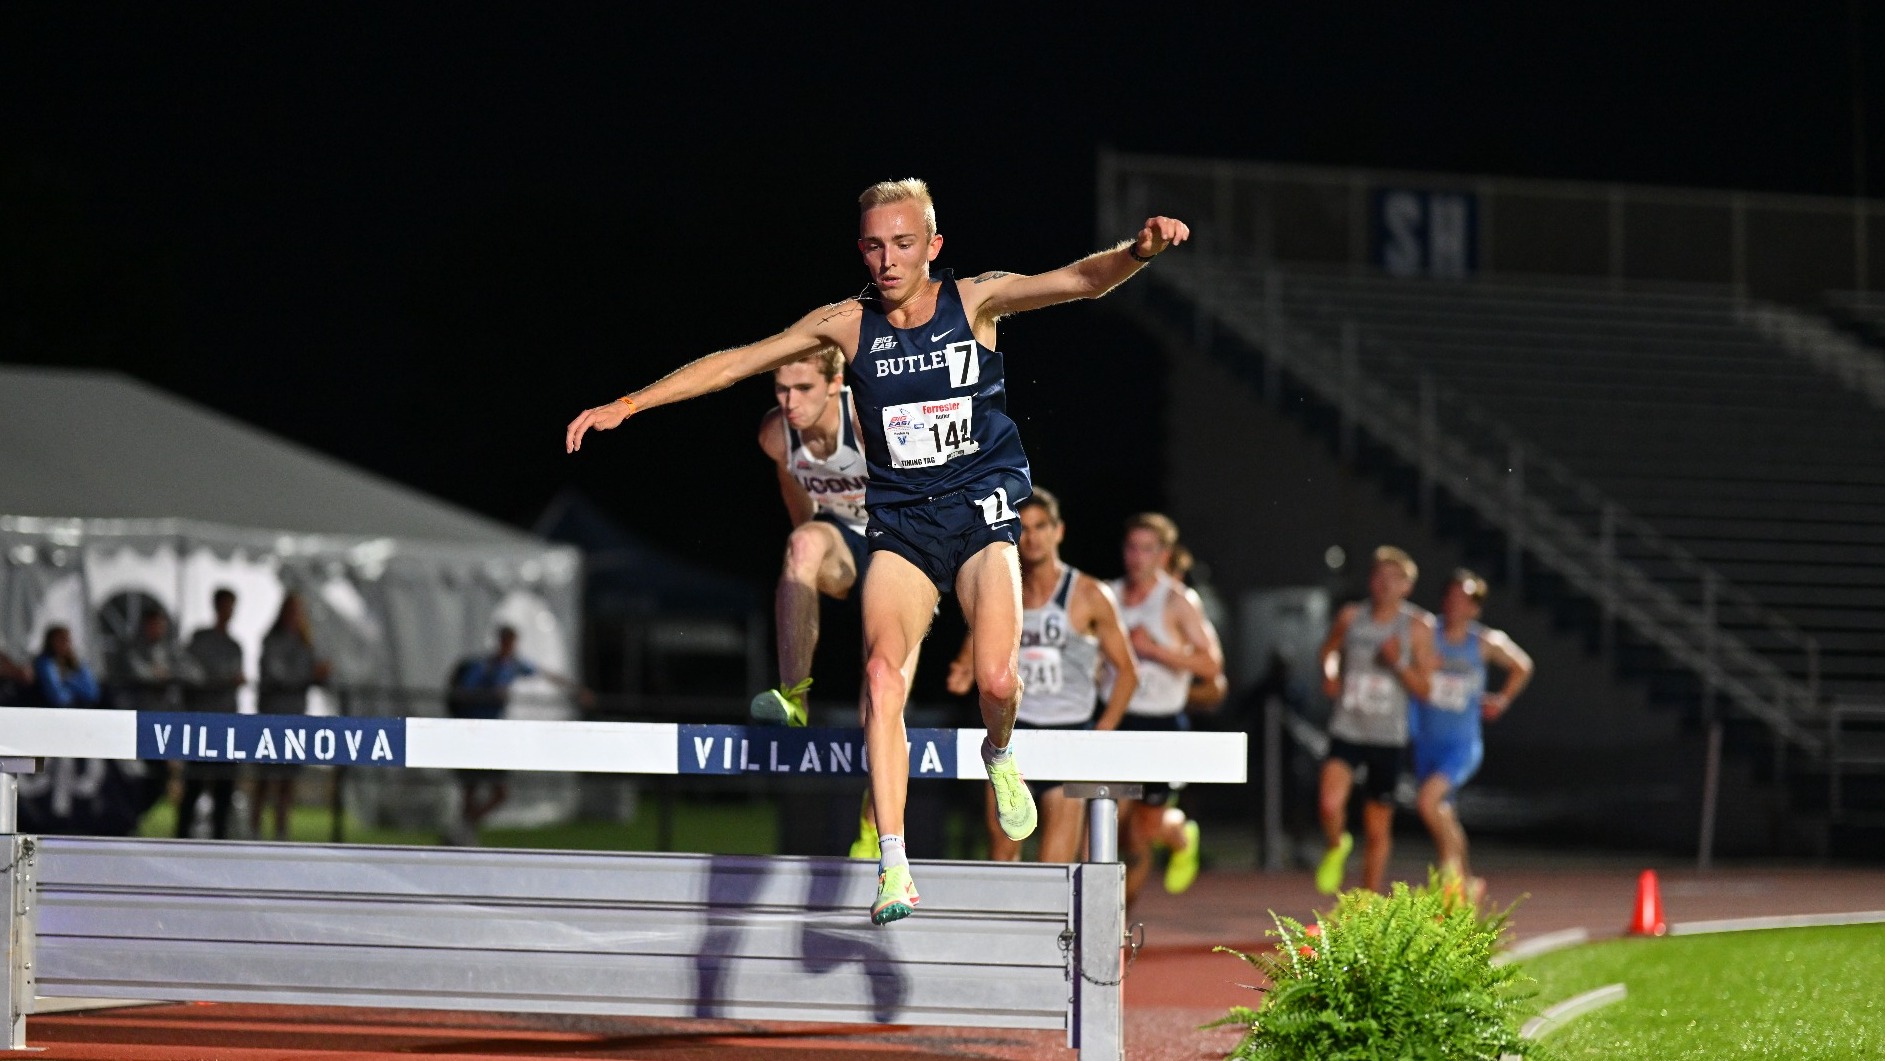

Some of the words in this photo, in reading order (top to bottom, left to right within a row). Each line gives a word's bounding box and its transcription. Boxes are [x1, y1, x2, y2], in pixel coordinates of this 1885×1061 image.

[871, 341, 898, 350] EAST
[874, 335, 894, 343] BIG
[954, 344, 972, 385] 7
[922, 402, 960, 415] Forrester
[900, 458, 923, 467] TIMING
[923, 456, 936, 465] TAG
[1044, 613, 1061, 643] 6
[1022, 664, 1057, 687] 241
[153, 723, 393, 761] VILLANOVA
[693, 736, 944, 773] VILLANA
